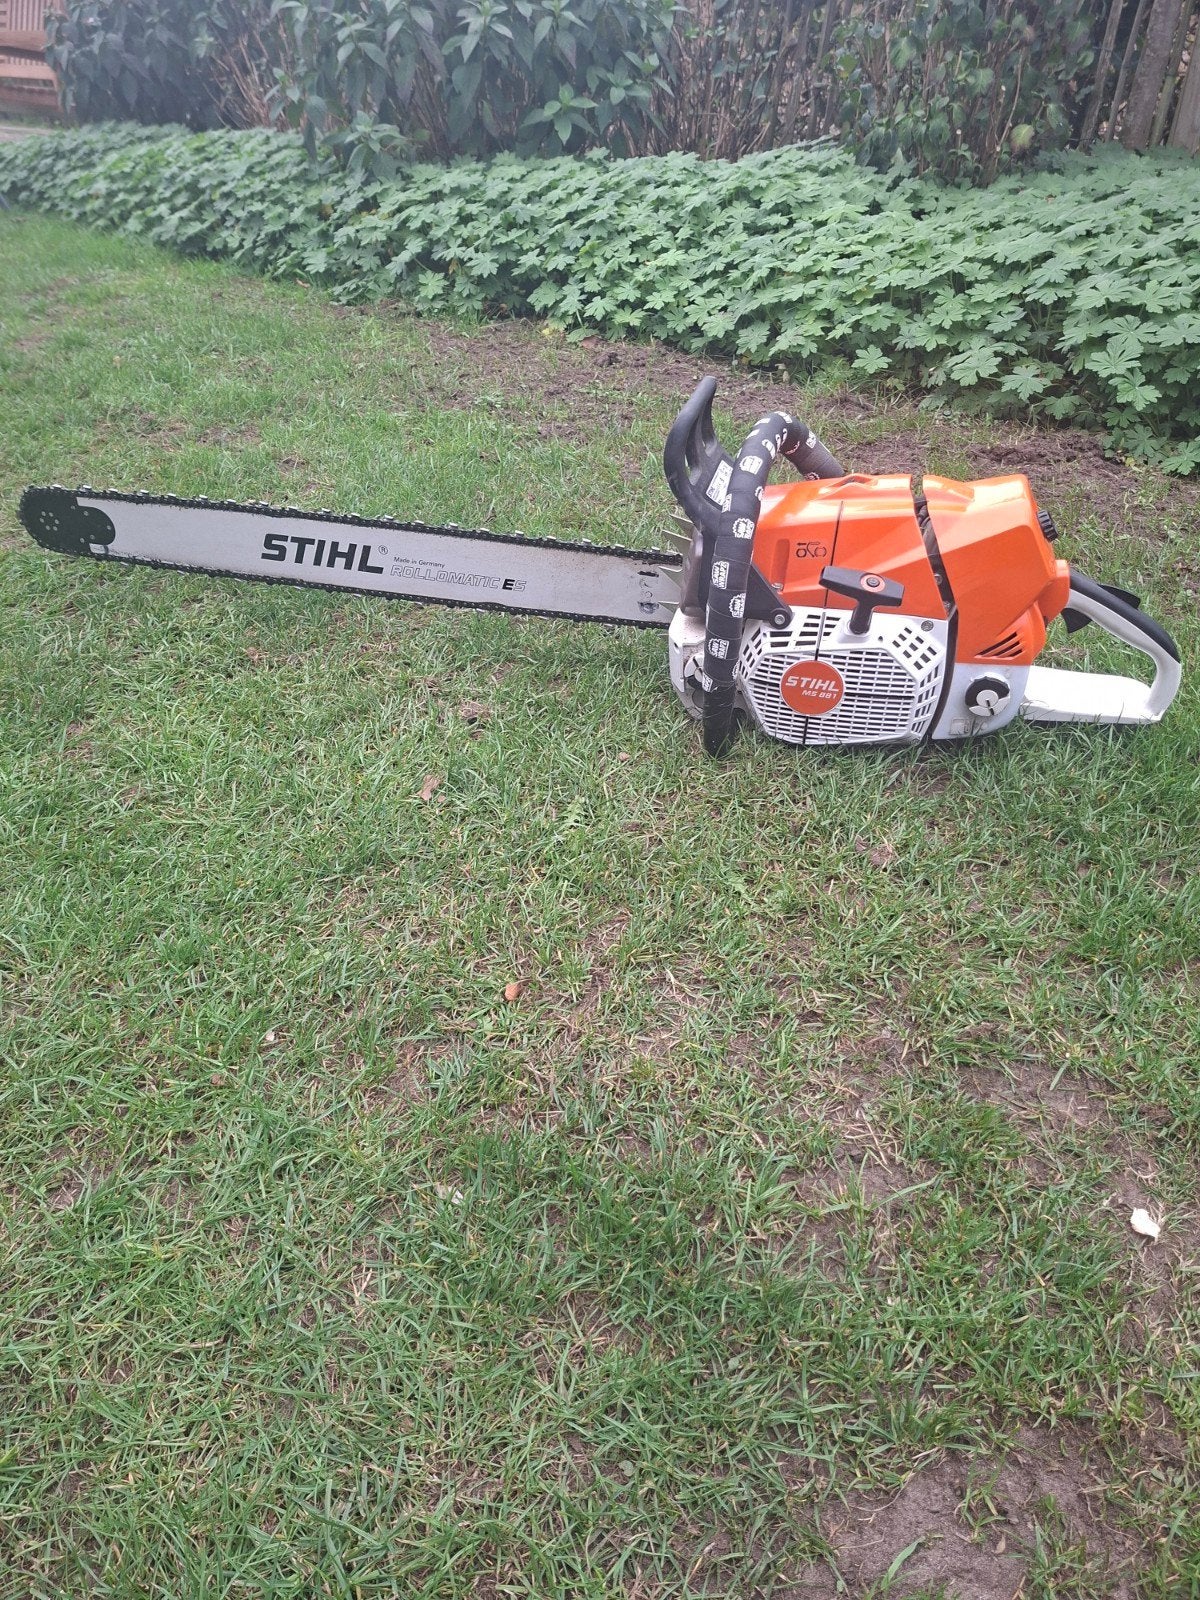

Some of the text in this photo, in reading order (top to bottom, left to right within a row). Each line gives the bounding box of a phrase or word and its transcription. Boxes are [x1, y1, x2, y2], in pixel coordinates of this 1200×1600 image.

[261, 533, 384, 575] STIHL
[393, 556, 410, 565] Made
[418, 559, 446, 569] Germany
[390, 564, 527, 592] ROLLOMATIC ES
[718, 562, 727, 588] WRAPZ
[785, 675, 839, 692] STIHL
[819, 691, 837, 699] 881
